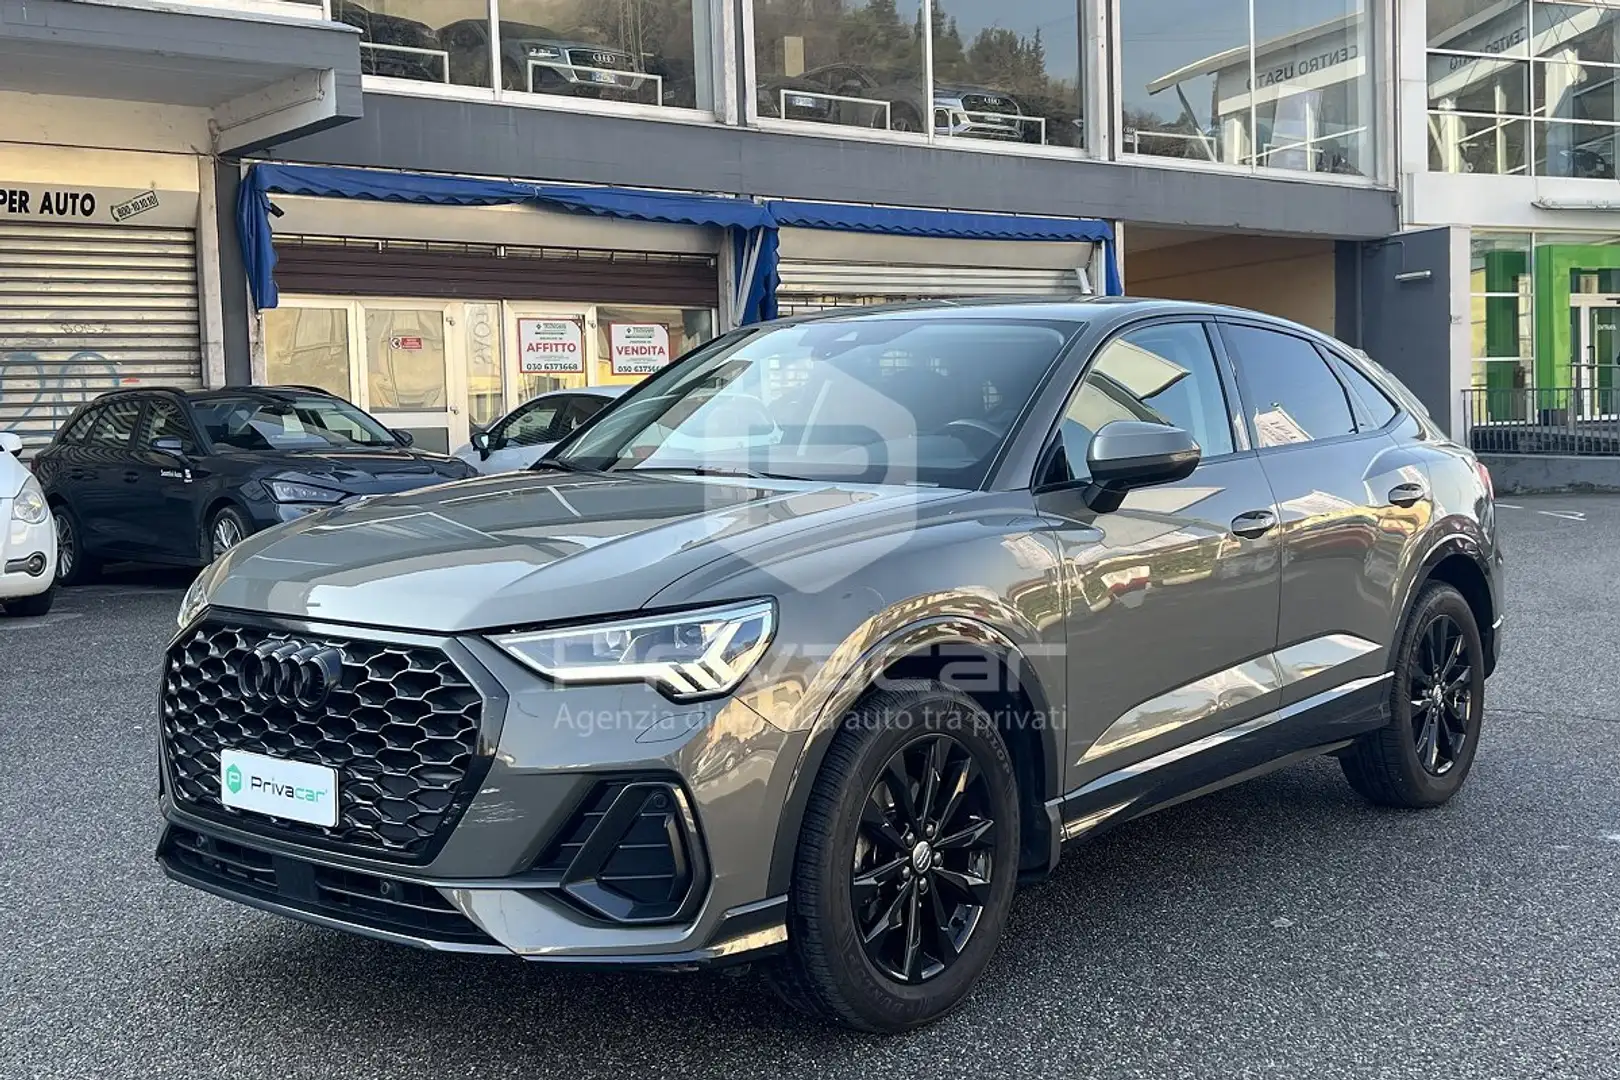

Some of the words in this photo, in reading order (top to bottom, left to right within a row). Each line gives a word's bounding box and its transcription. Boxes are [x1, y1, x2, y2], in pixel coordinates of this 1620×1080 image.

[39, 191, 96, 217] AUTO
[526, 342, 577, 353] AFFITTO
[615, 345, 666, 356] VENDITA
[251, 775, 326, 803] Privacar
